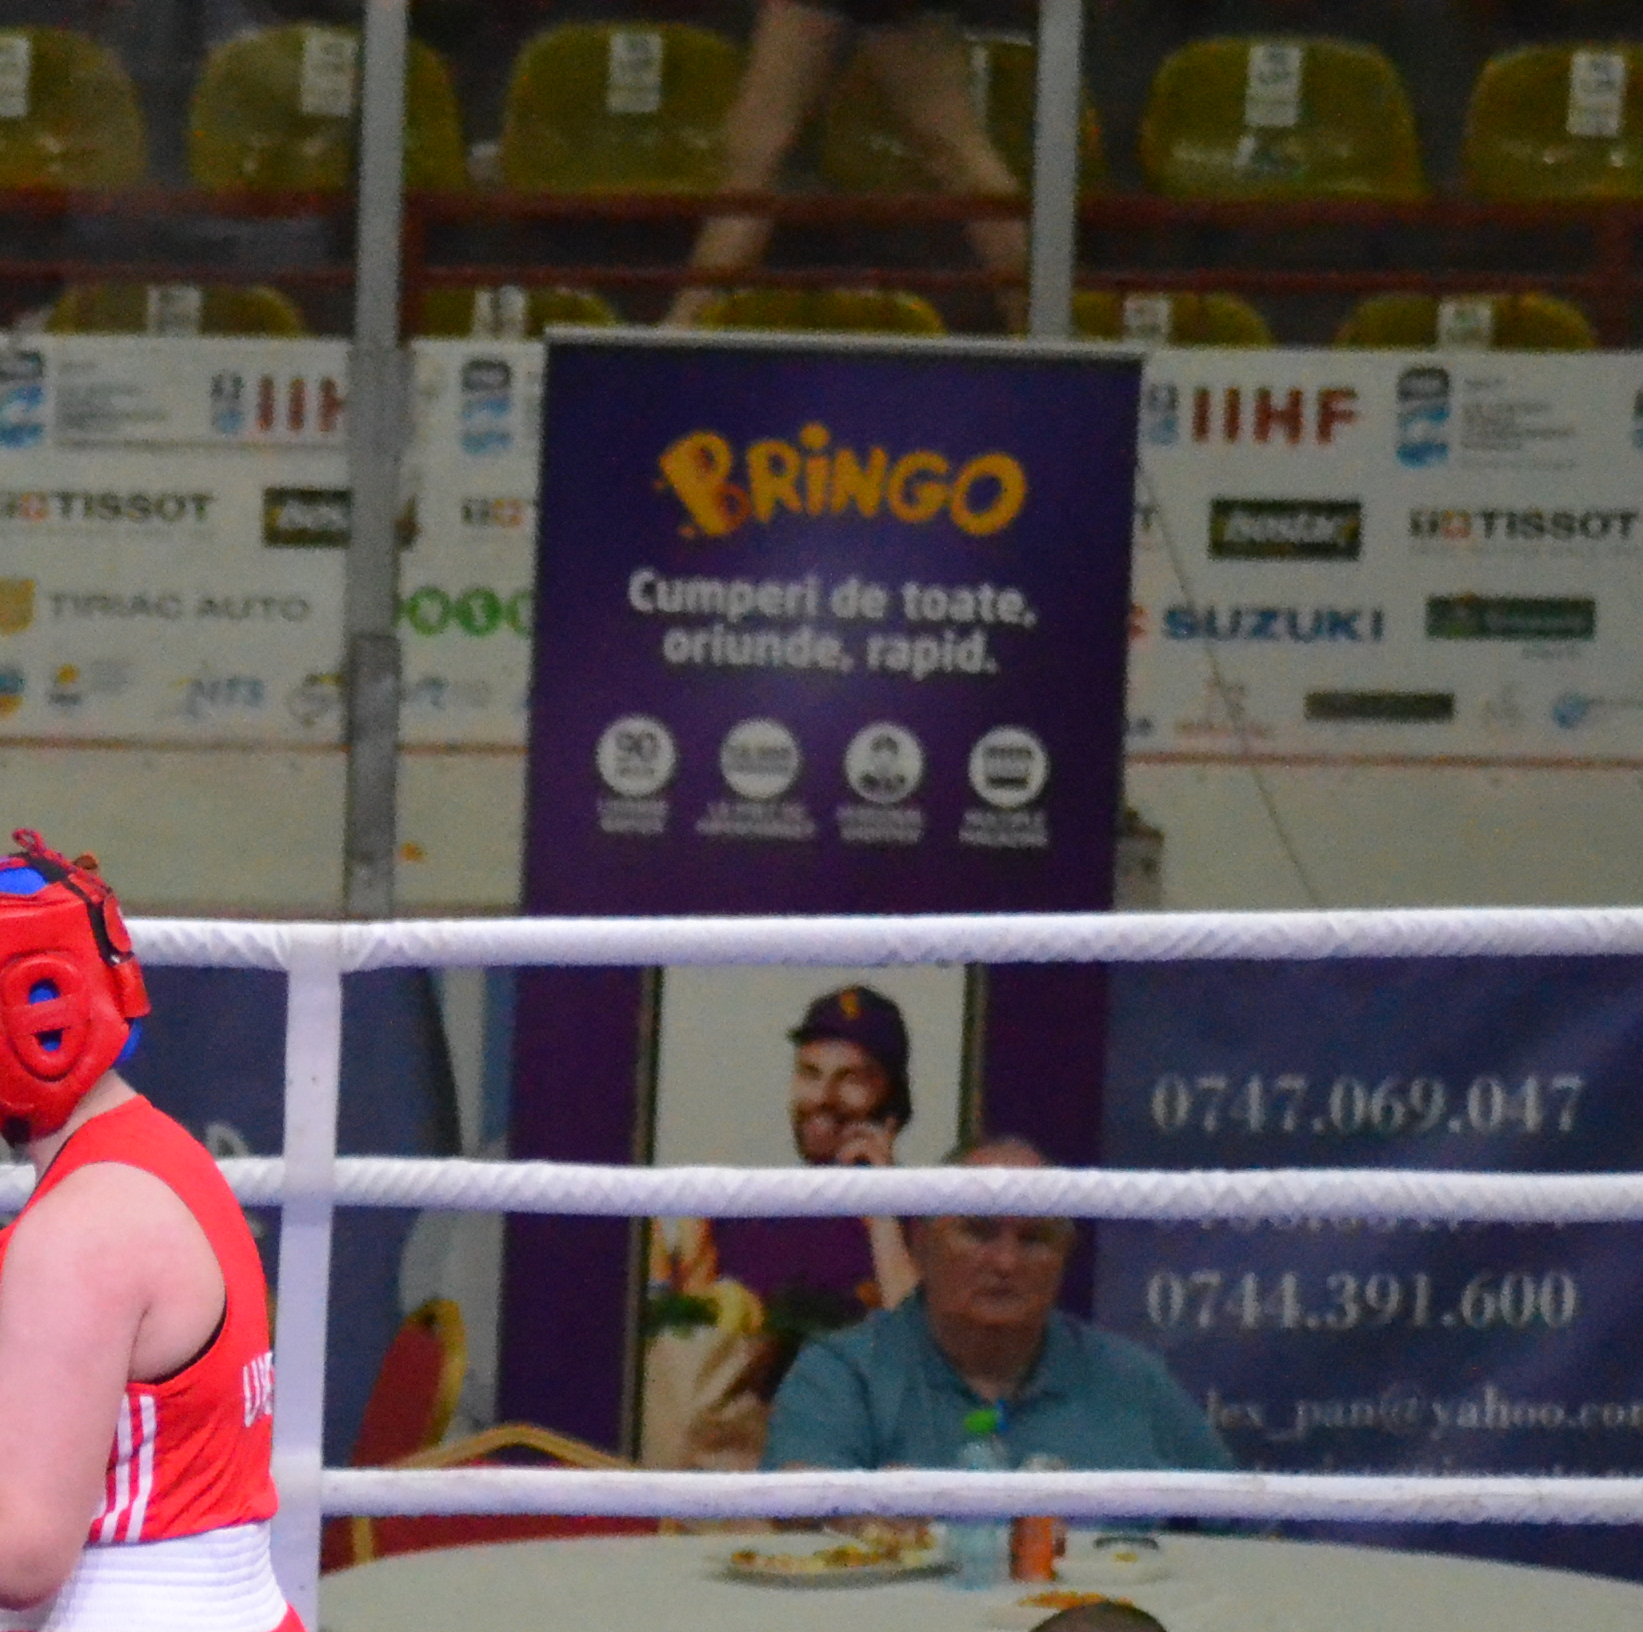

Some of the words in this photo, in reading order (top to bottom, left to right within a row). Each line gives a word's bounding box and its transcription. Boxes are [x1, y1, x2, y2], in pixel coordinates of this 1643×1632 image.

[1191, 385, 1360, 446] IIHF
[58, 492, 214, 523] TISSOT
[1480, 508, 1640, 540] TISSOT
[195, 594, 312, 622] AUTO
[627, 567, 817, 622] Cumperi
[828, 577, 887, 620] de
[1162, 607, 1385, 643] SUZUKI
[865, 630, 999, 682] rapid.
[1150, 1073, 1587, 1136] 0747.069.047
[1145, 1271, 1579, 1332] 0744.391.600
